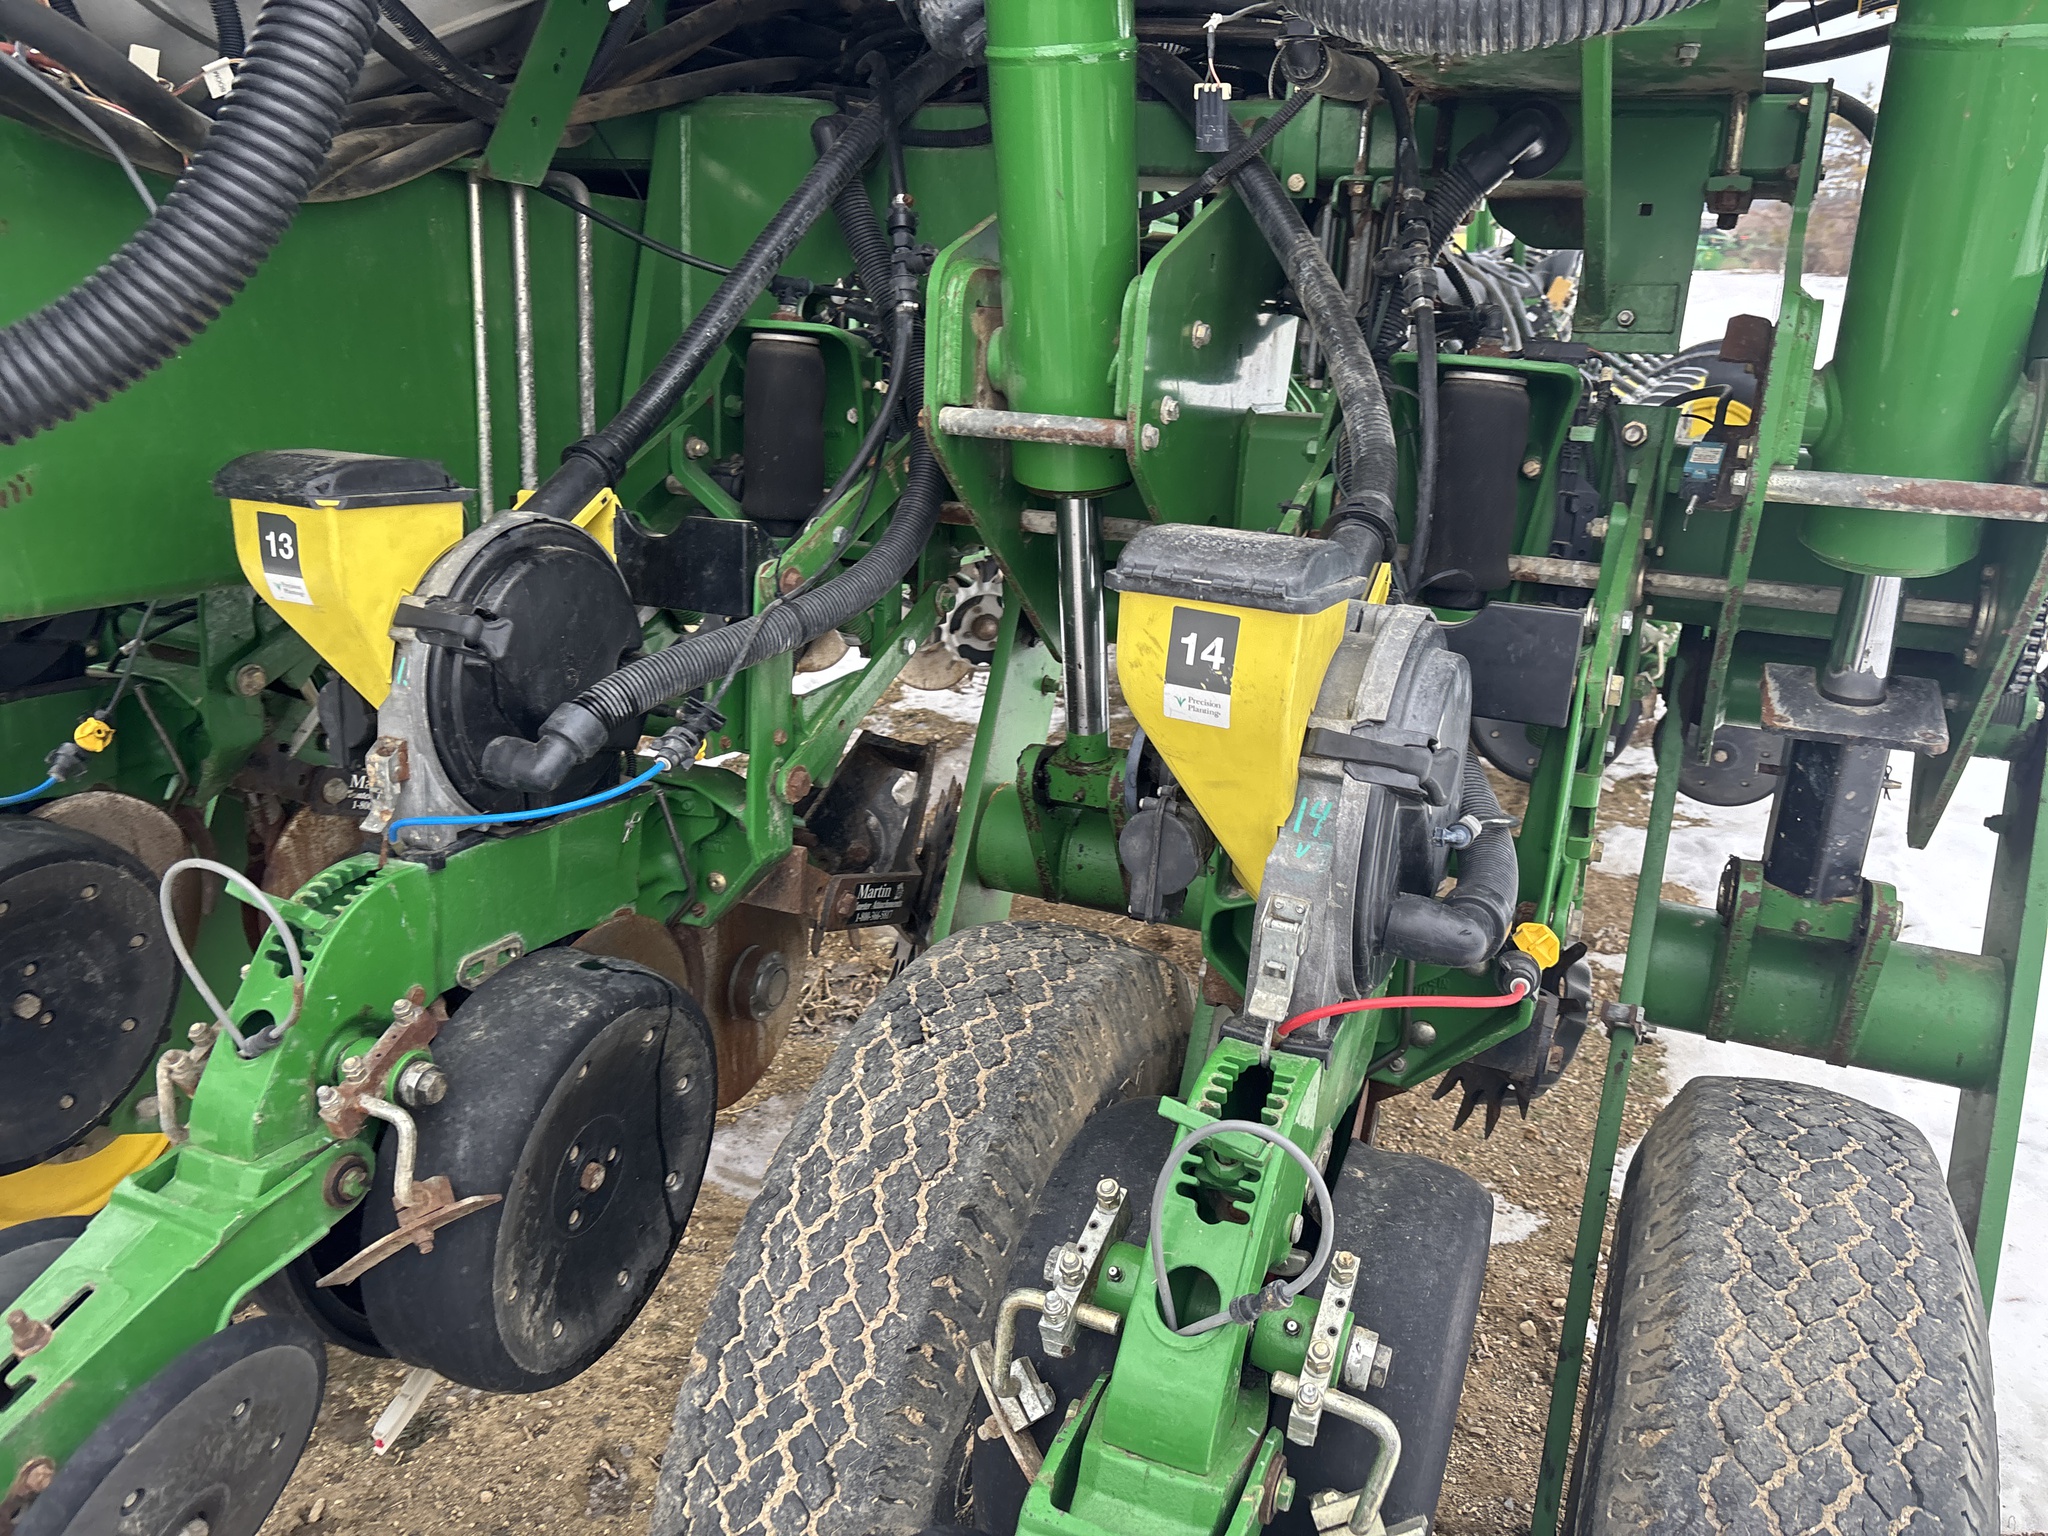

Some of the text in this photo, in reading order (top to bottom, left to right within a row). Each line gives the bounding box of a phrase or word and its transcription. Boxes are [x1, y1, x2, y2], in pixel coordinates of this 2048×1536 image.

[265, 531, 294, 560] 13
[1181, 632, 1225, 671] 14
[1188, 696, 1221, 709] Precision
[1293, 797, 1333, 837] 14
[857, 883, 892, 899] Martin
